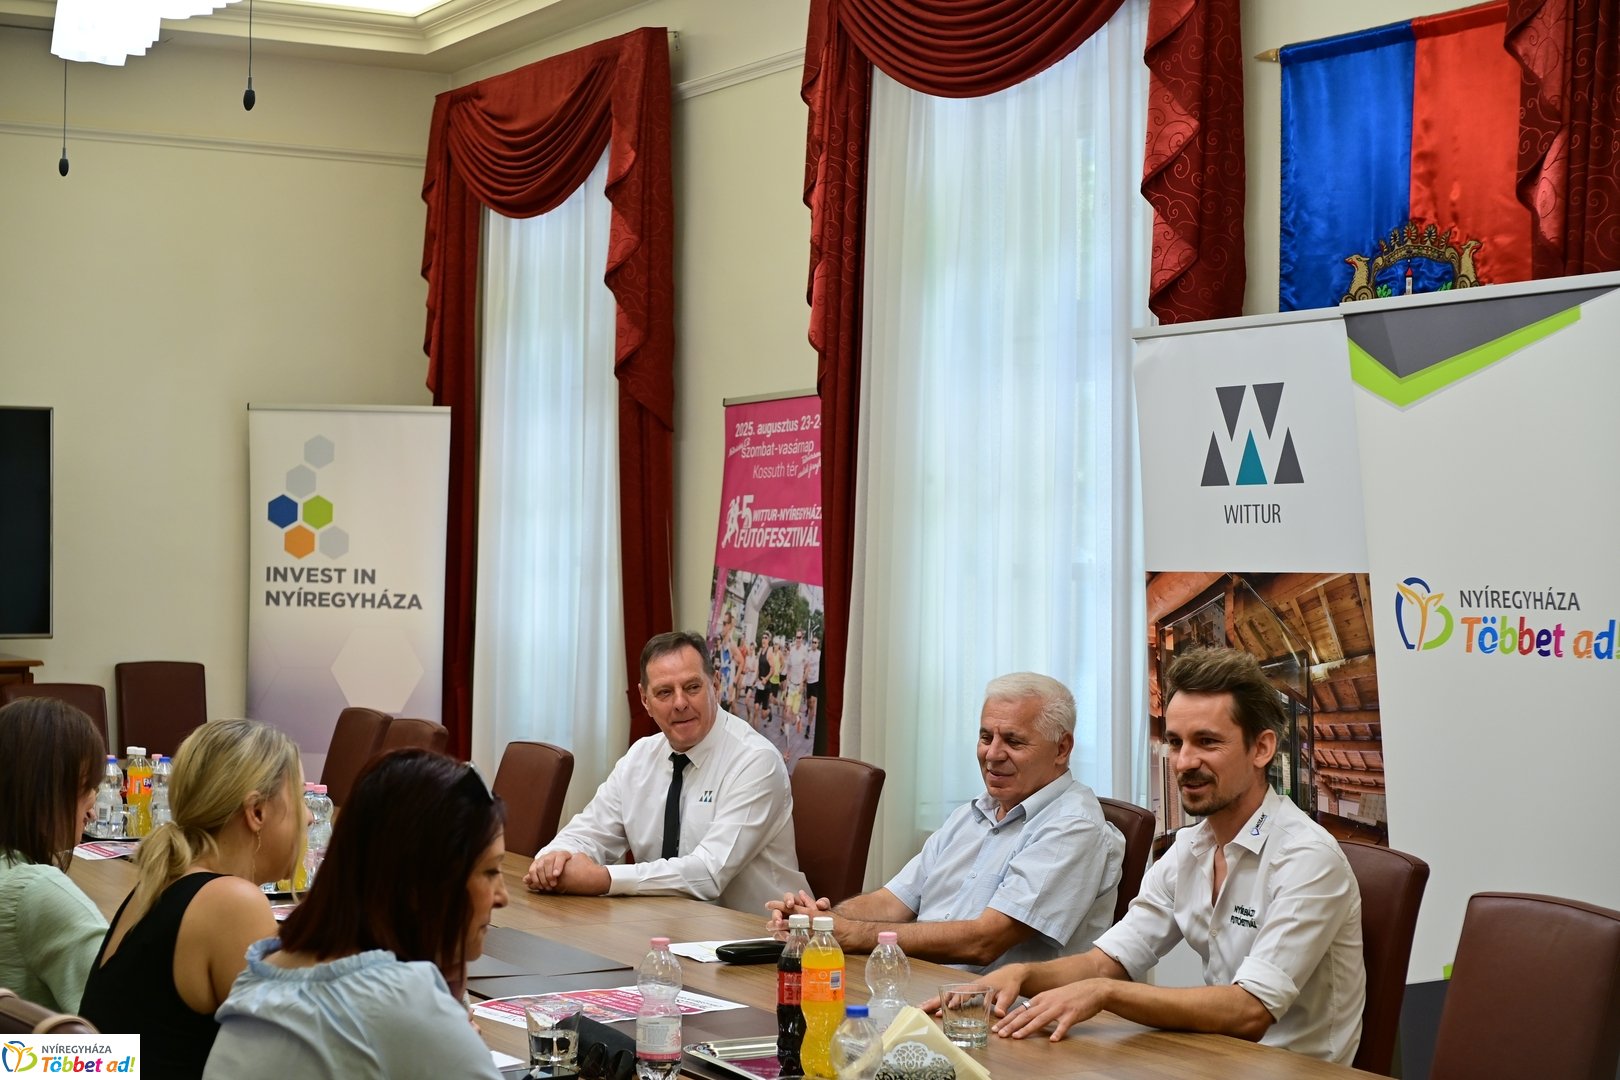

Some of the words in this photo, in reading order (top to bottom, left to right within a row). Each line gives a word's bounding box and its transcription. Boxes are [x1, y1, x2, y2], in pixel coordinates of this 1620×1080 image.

[735, 421, 755, 437] 2025.
[757, 418, 798, 437] augusztus
[800, 414, 821, 430] 23-2
[741, 438, 814, 458] szombat-vasárnap
[752, 461, 786, 479] Kossuth
[786, 461, 799, 476] tér
[752, 504, 822, 522] WITTUR-NYÍREGYHÁZ
[1223, 503, 1282, 524] WITTUR
[739, 521, 820, 548] FUTÓFESZTIVÁL
[265, 566, 347, 584] INVEST
[353, 568, 376, 585] IN
[265, 587, 423, 610] NYÍREGYHÁZA
[1459, 585, 1581, 611] NYÍREGYHÁZA
[1460, 615, 1566, 658] Többet
